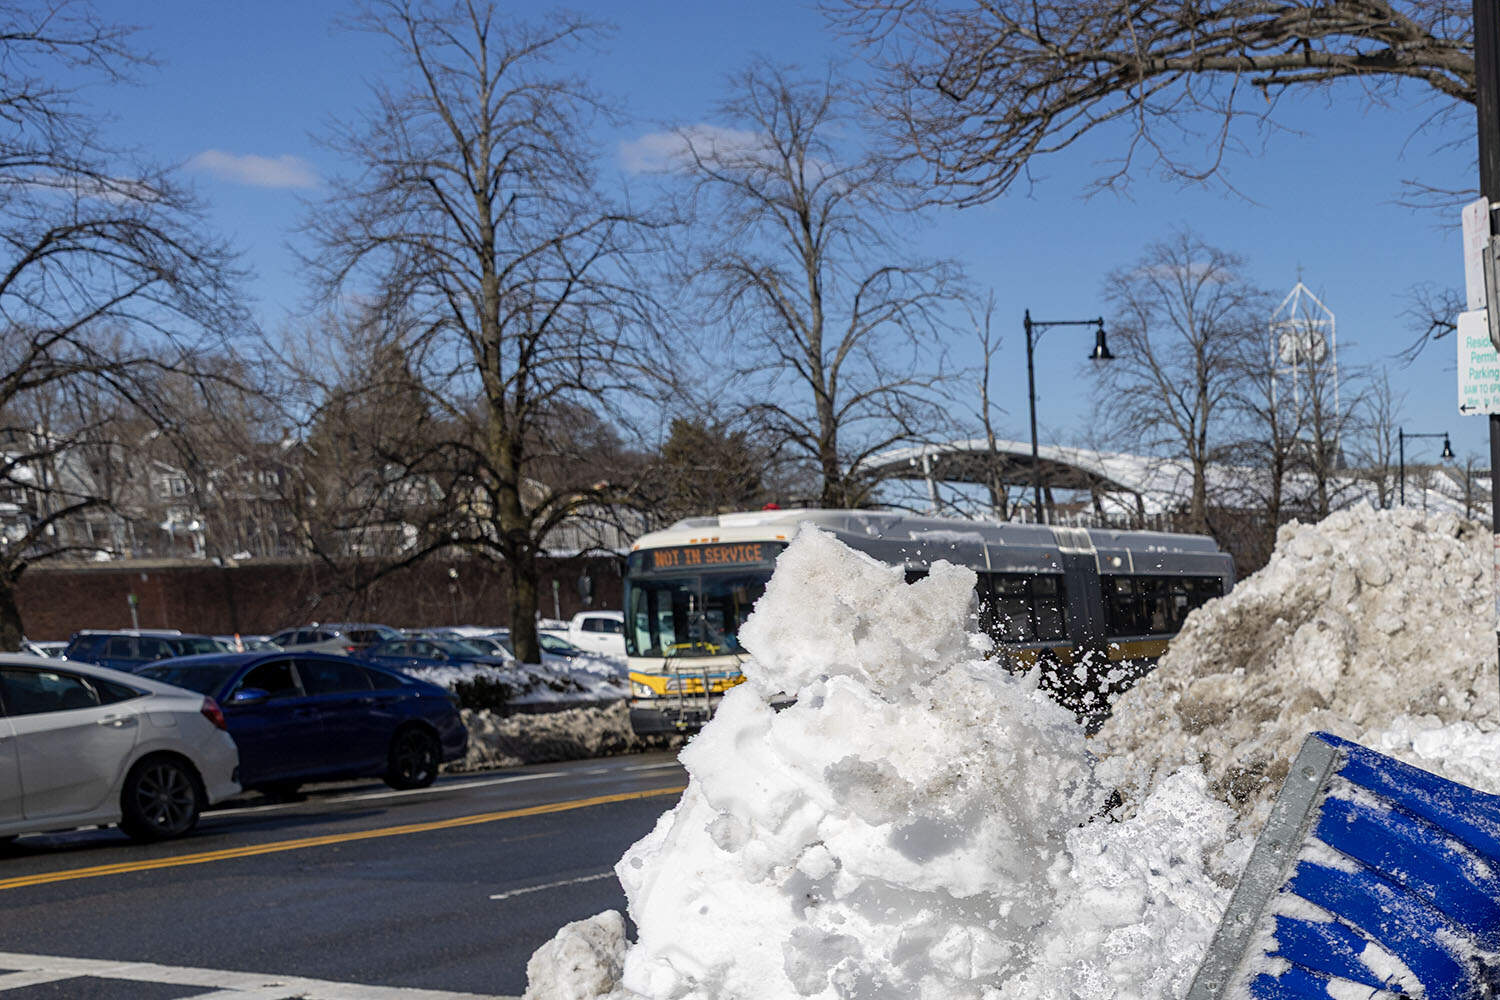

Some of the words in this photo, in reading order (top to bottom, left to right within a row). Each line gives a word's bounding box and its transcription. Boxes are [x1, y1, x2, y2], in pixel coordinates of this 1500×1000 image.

[1471, 351, 1498, 363] Permit
[1469, 367, 1500, 381] Parking
[654, 549, 679, 568] NOT
[684, 548, 701, 565] IN
[704, 544, 763, 564] SERVICE
